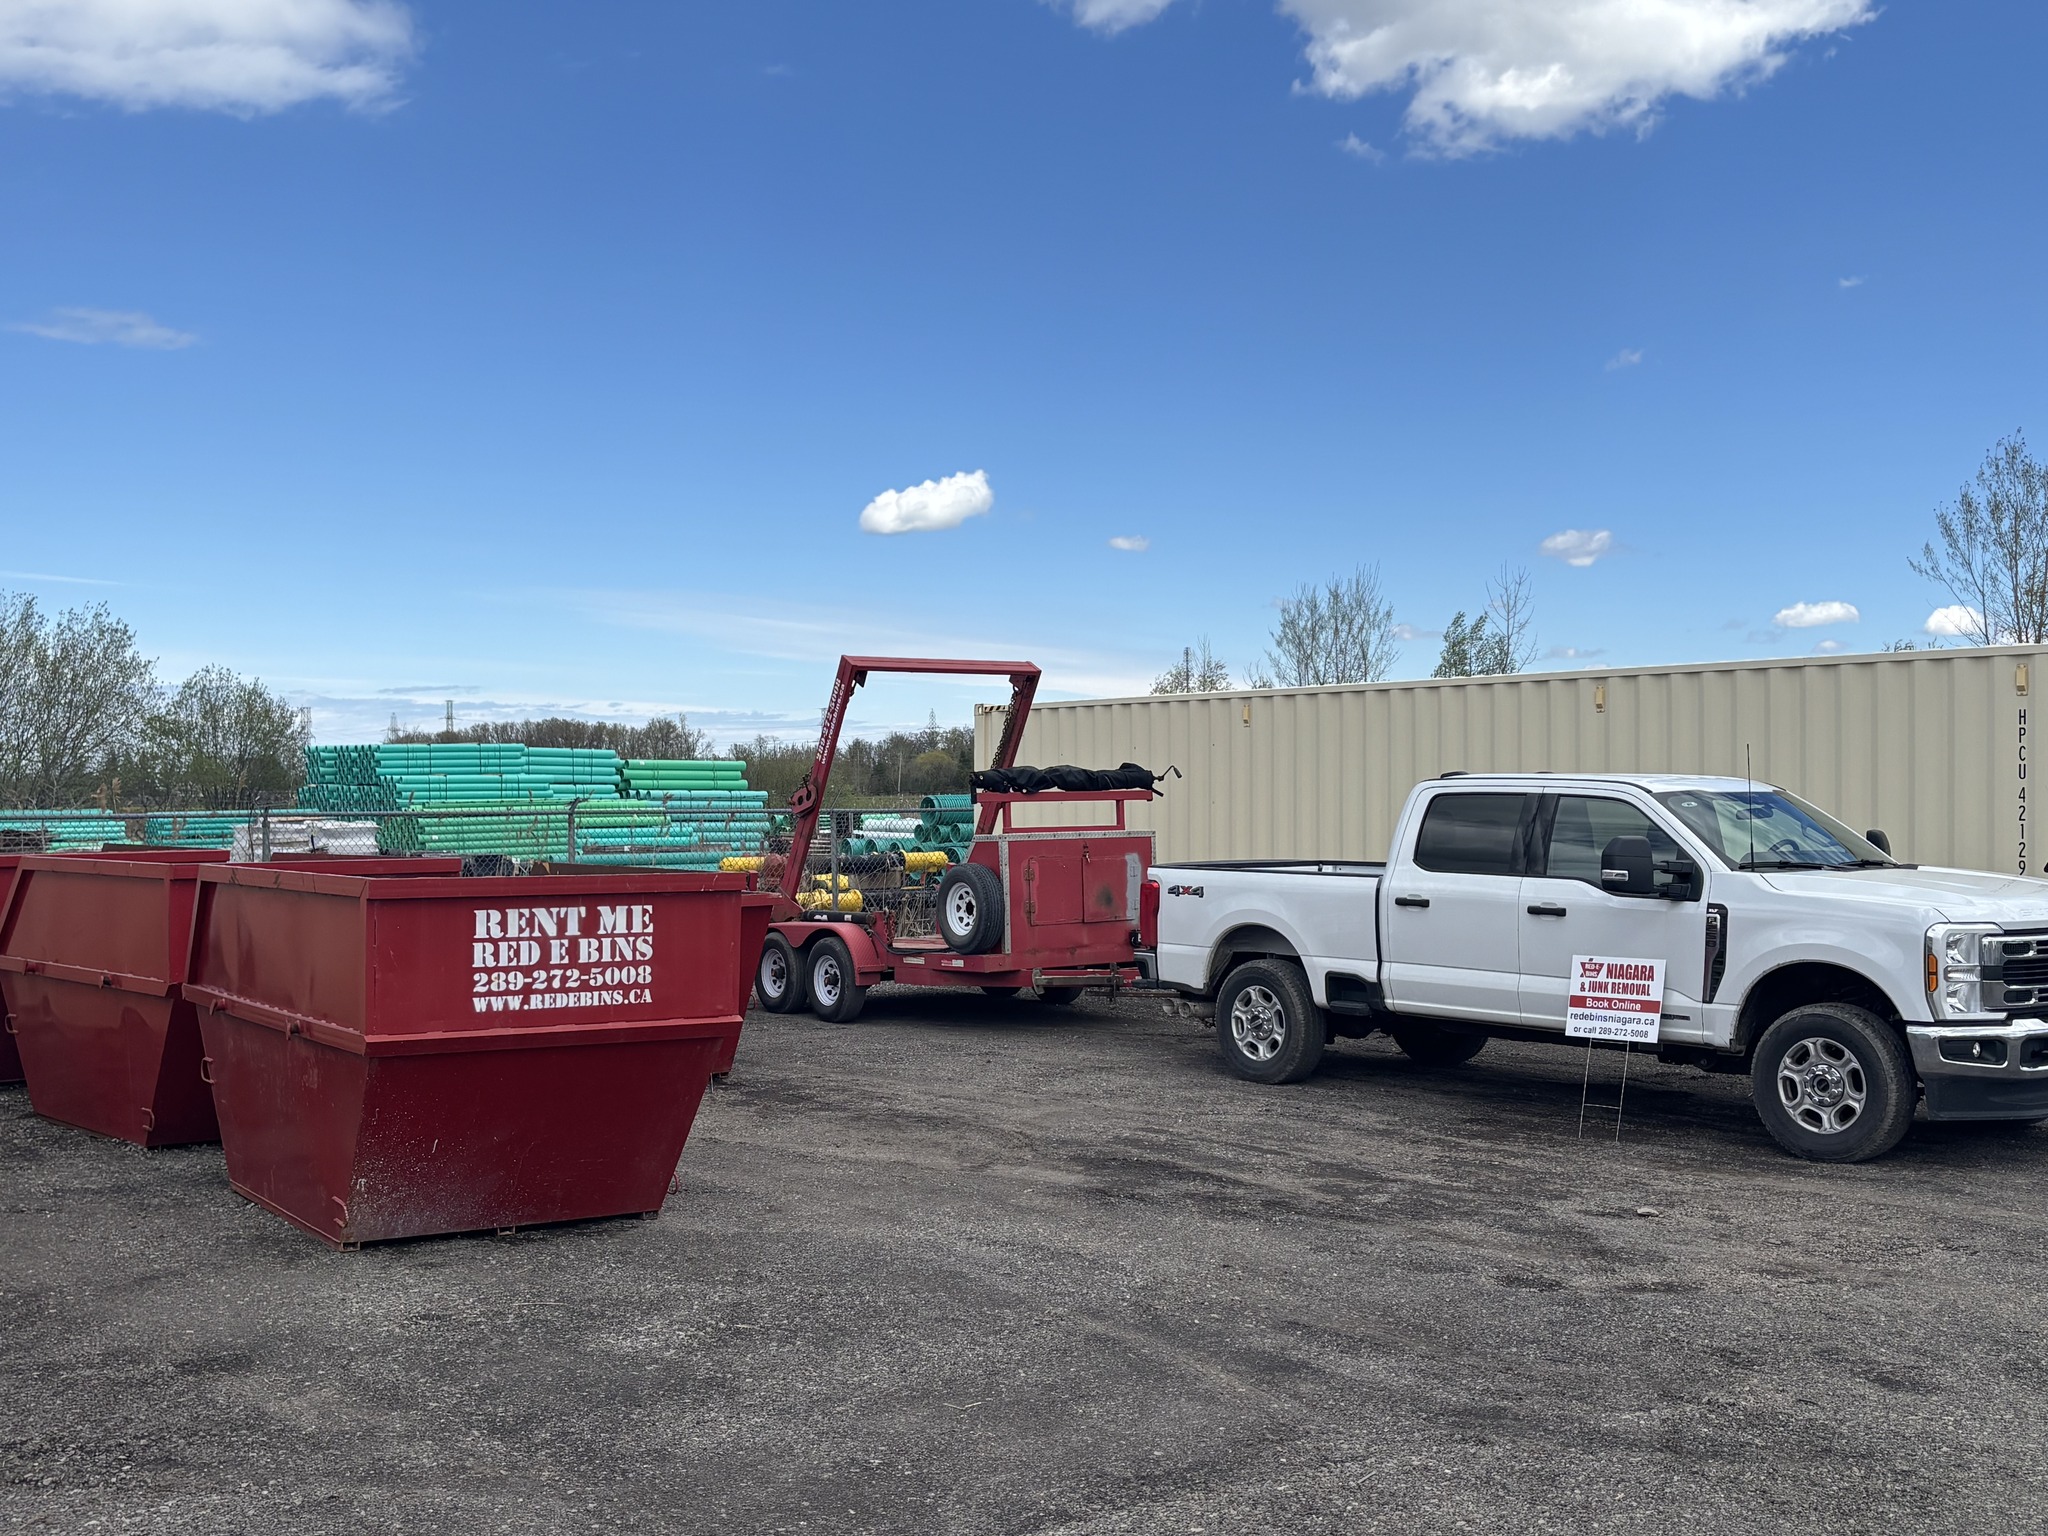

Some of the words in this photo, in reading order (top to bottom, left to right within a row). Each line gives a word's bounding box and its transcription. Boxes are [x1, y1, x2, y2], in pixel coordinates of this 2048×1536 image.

[2018, 708, 2027, 780] HPCU
[473, 906, 587, 939] RENT
[597, 904, 654, 935] ME
[472, 940, 541, 968] RED
[549, 938, 569, 965] E
[578, 936, 654, 964] BINS
[472, 965, 653, 993] 289-272-5008
[1606, 963, 1655, 982] NIAGARA
[1580, 981, 1586, 992] &
[1588, 981, 1609, 994] JUNK
[1611, 982, 1651, 996] REMOVAL
[472, 988, 653, 1013] WWW.REDEBINS.CA
[1586, 998, 1609, 1009] Book
[1612, 999, 1641, 1011] Online
[1570, 1012, 1655, 1026] redebinsniagara.ca
[1583, 1026, 1596, 1034] call
[1598, 1026, 1649, 1038] 289-272-5008
